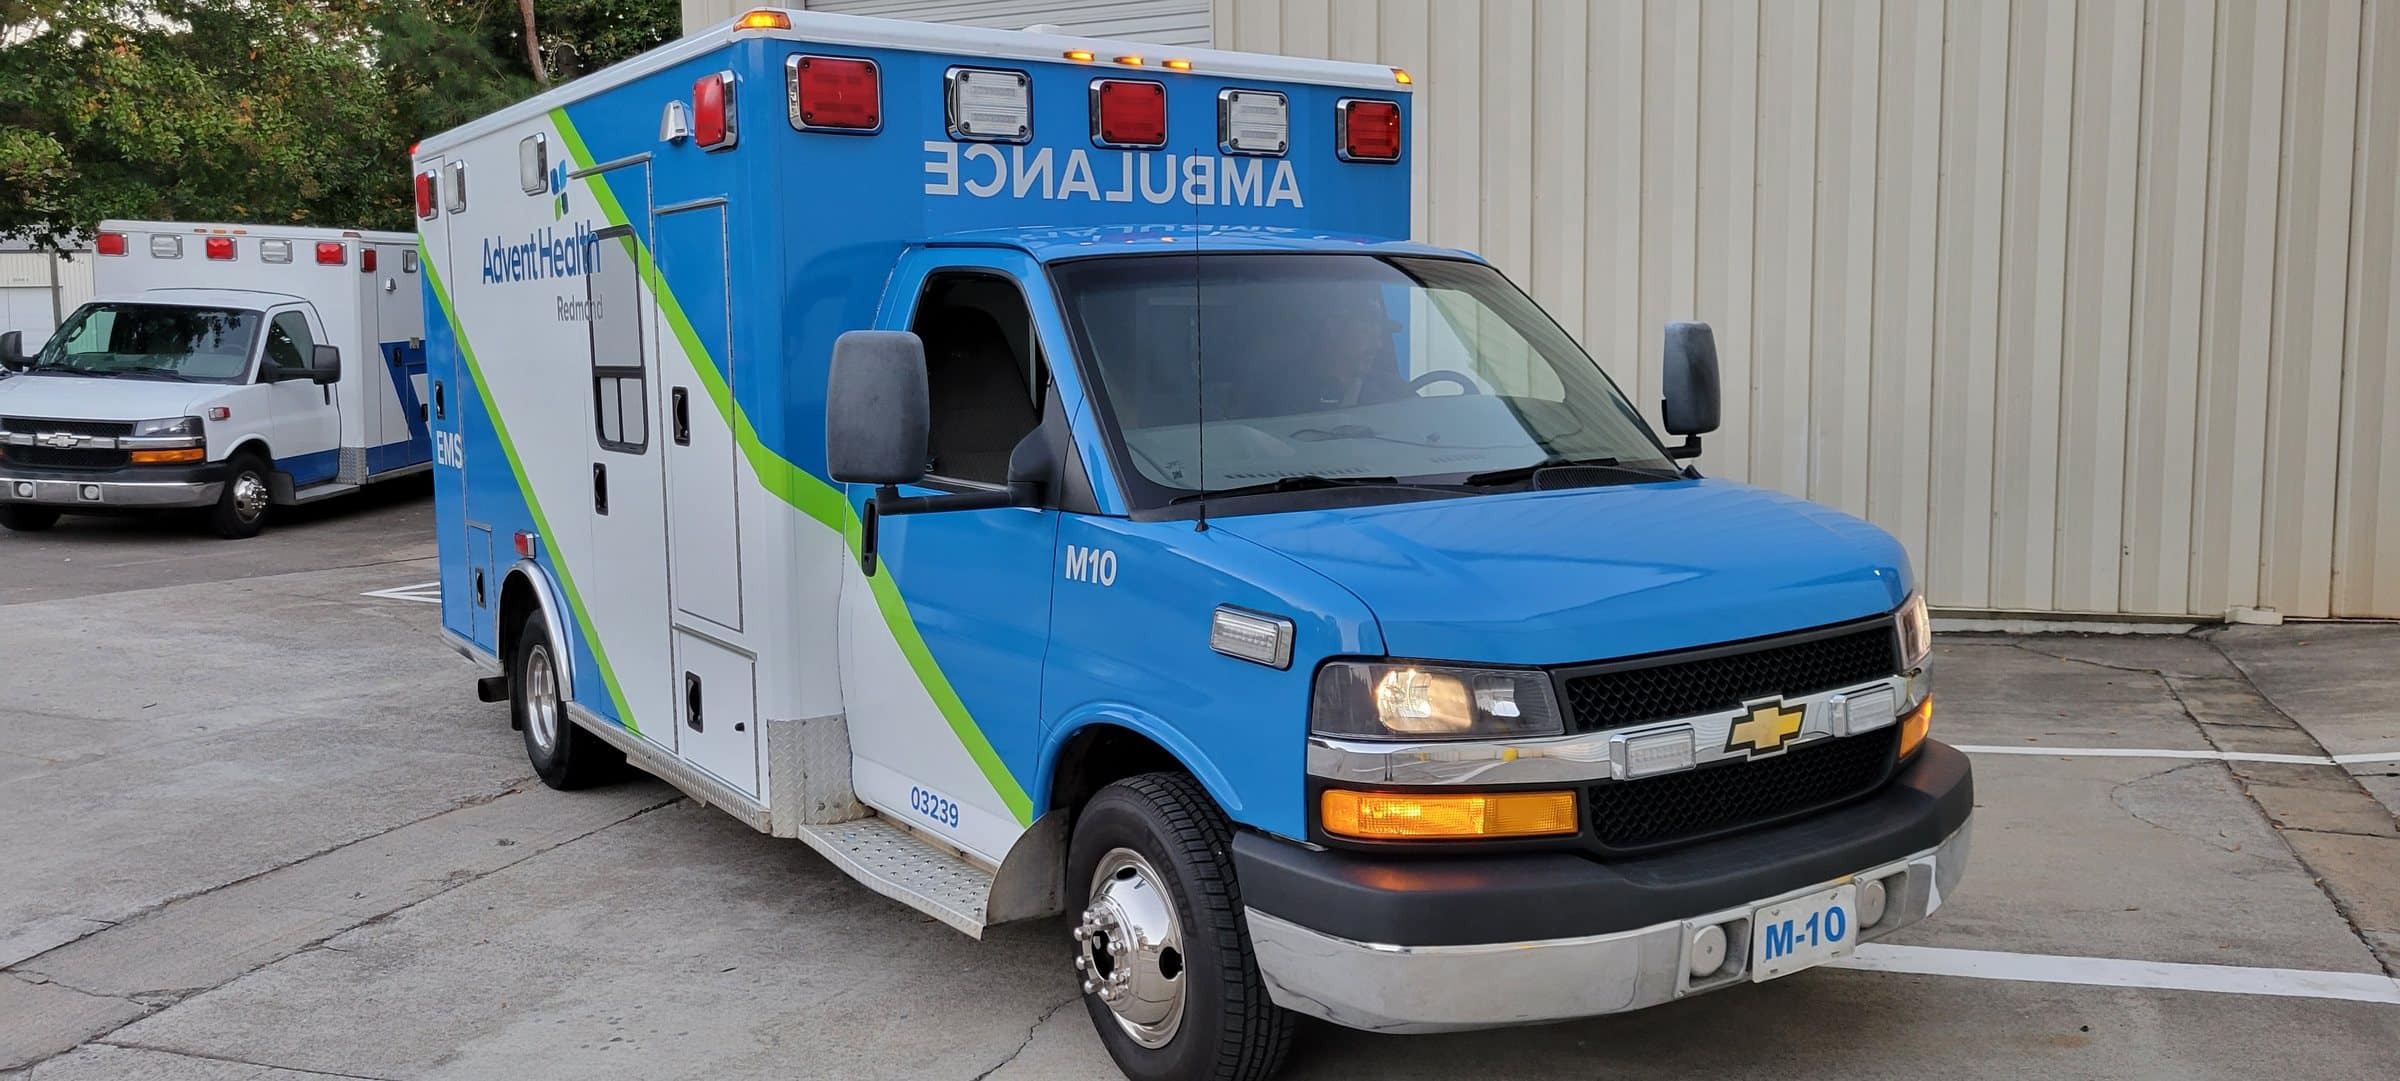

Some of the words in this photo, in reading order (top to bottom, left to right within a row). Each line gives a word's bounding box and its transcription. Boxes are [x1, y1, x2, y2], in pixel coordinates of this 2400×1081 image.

[557, 294, 603, 321] Redmond
[436, 430, 463, 469] EMS
[1065, 544, 1117, 587] M10
[911, 786, 959, 829] 03239
[1765, 905, 1846, 961] M-10
